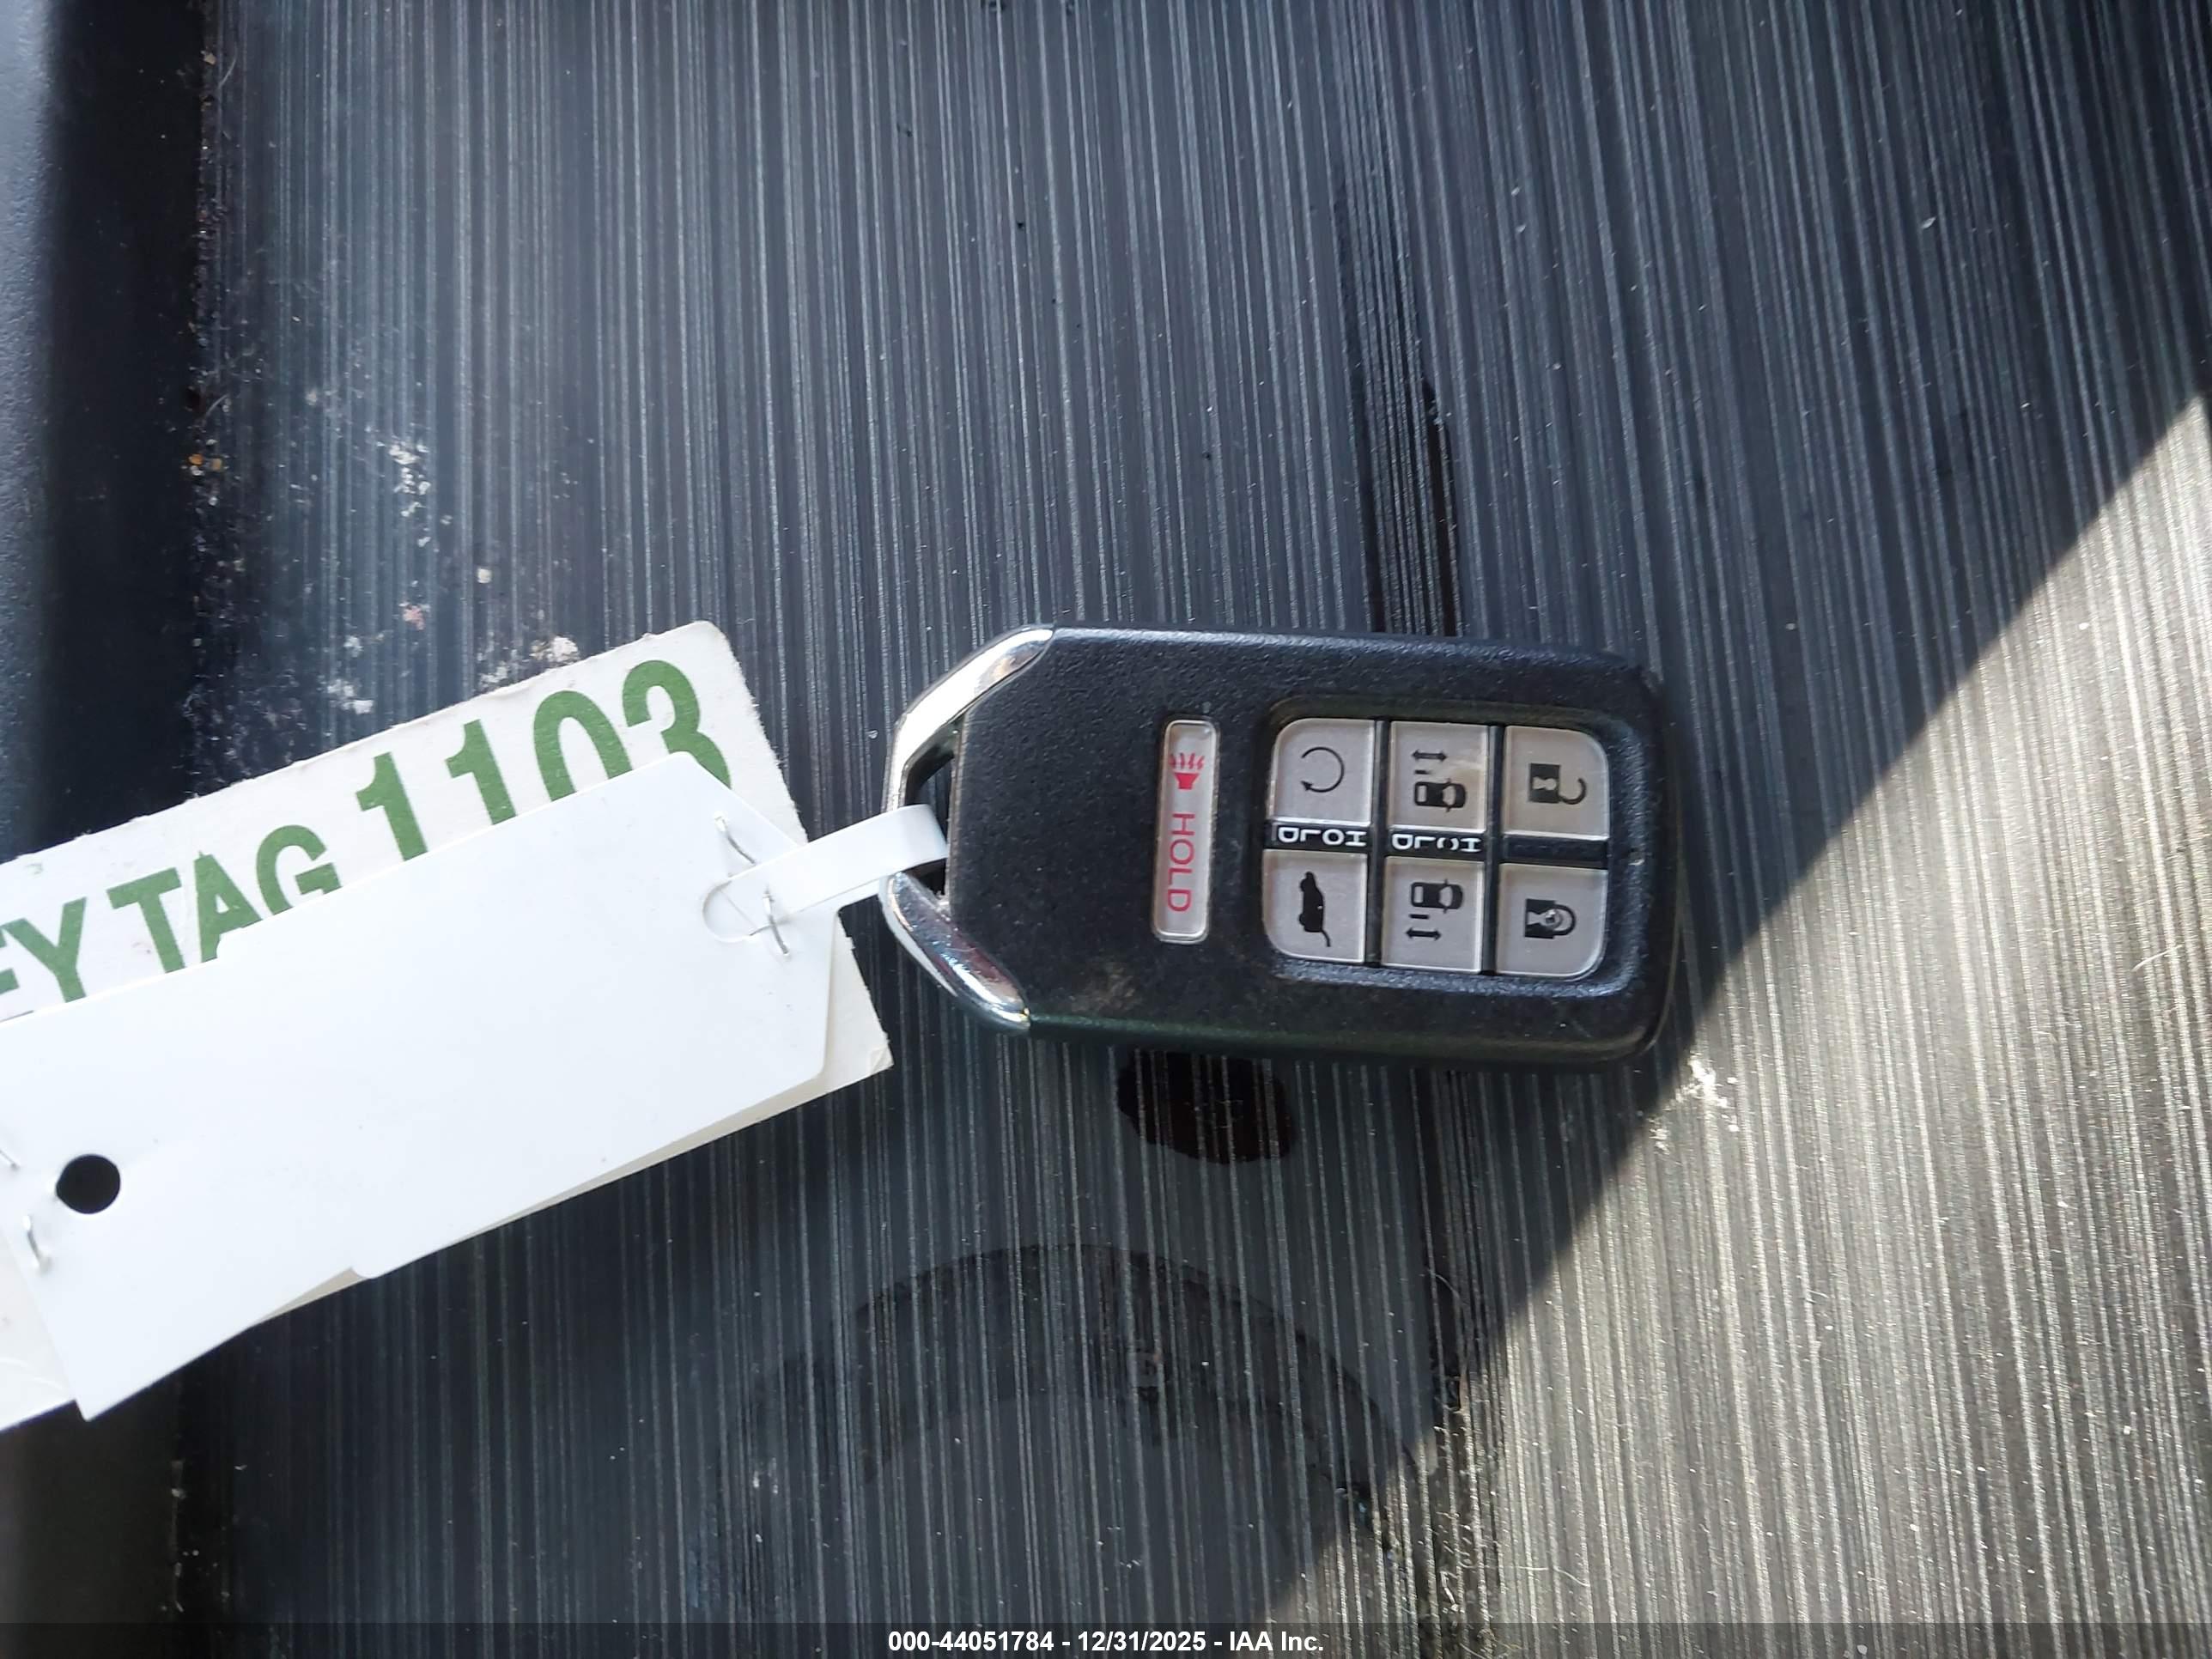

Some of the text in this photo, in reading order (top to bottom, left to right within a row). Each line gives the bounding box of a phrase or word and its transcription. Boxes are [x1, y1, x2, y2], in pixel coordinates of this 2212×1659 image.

[106, 824, 343, 973] TAG
[355, 659, 731, 862] 1103
[1167, 813, 1195, 913] HOLD
[1277, 826, 1367, 847] HOLD
